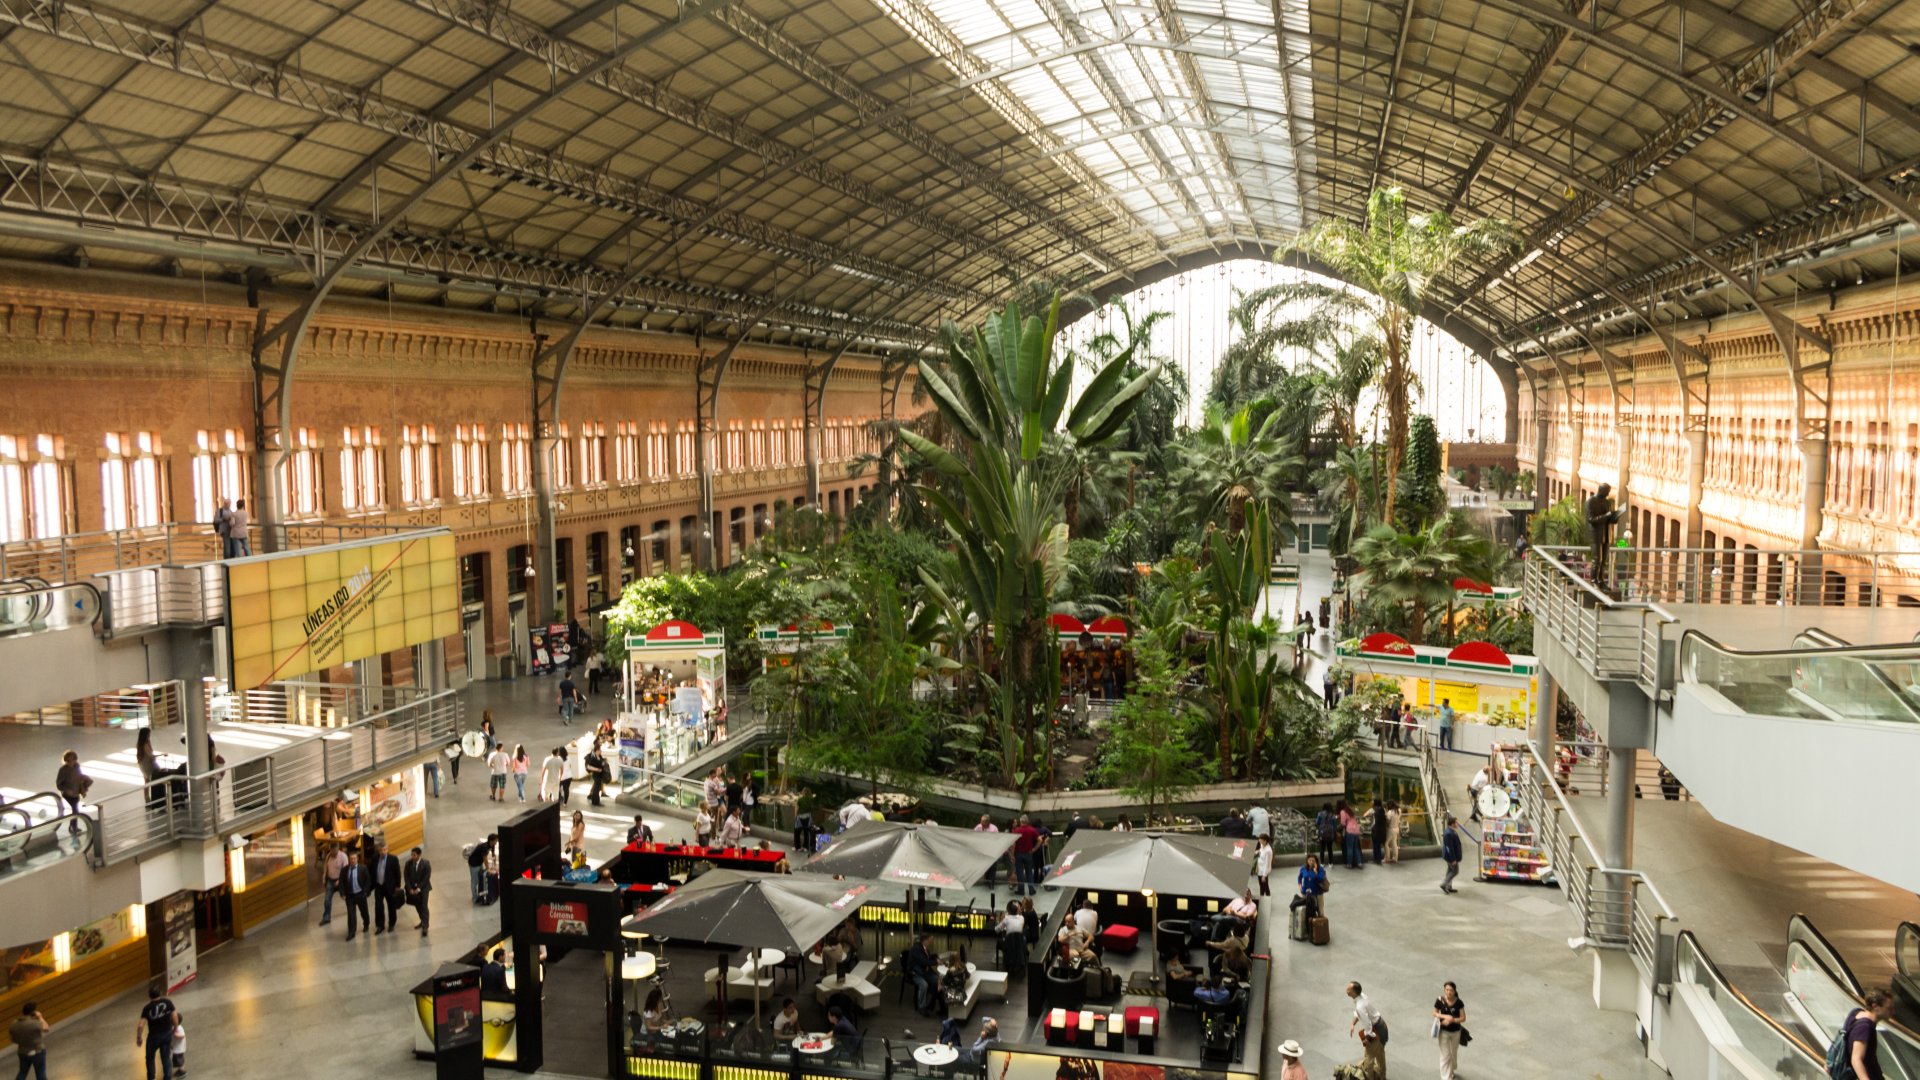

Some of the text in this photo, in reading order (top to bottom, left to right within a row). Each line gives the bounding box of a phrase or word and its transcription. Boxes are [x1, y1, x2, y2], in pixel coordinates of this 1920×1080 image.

[302, 564, 373, 638] LÍNEAS ICO 2014
[333, 628, 340, 637] de
[898, 869, 929, 880] WINE
[446, 979, 463, 988] WINE
[149, 1002, 167, 1020] U2
